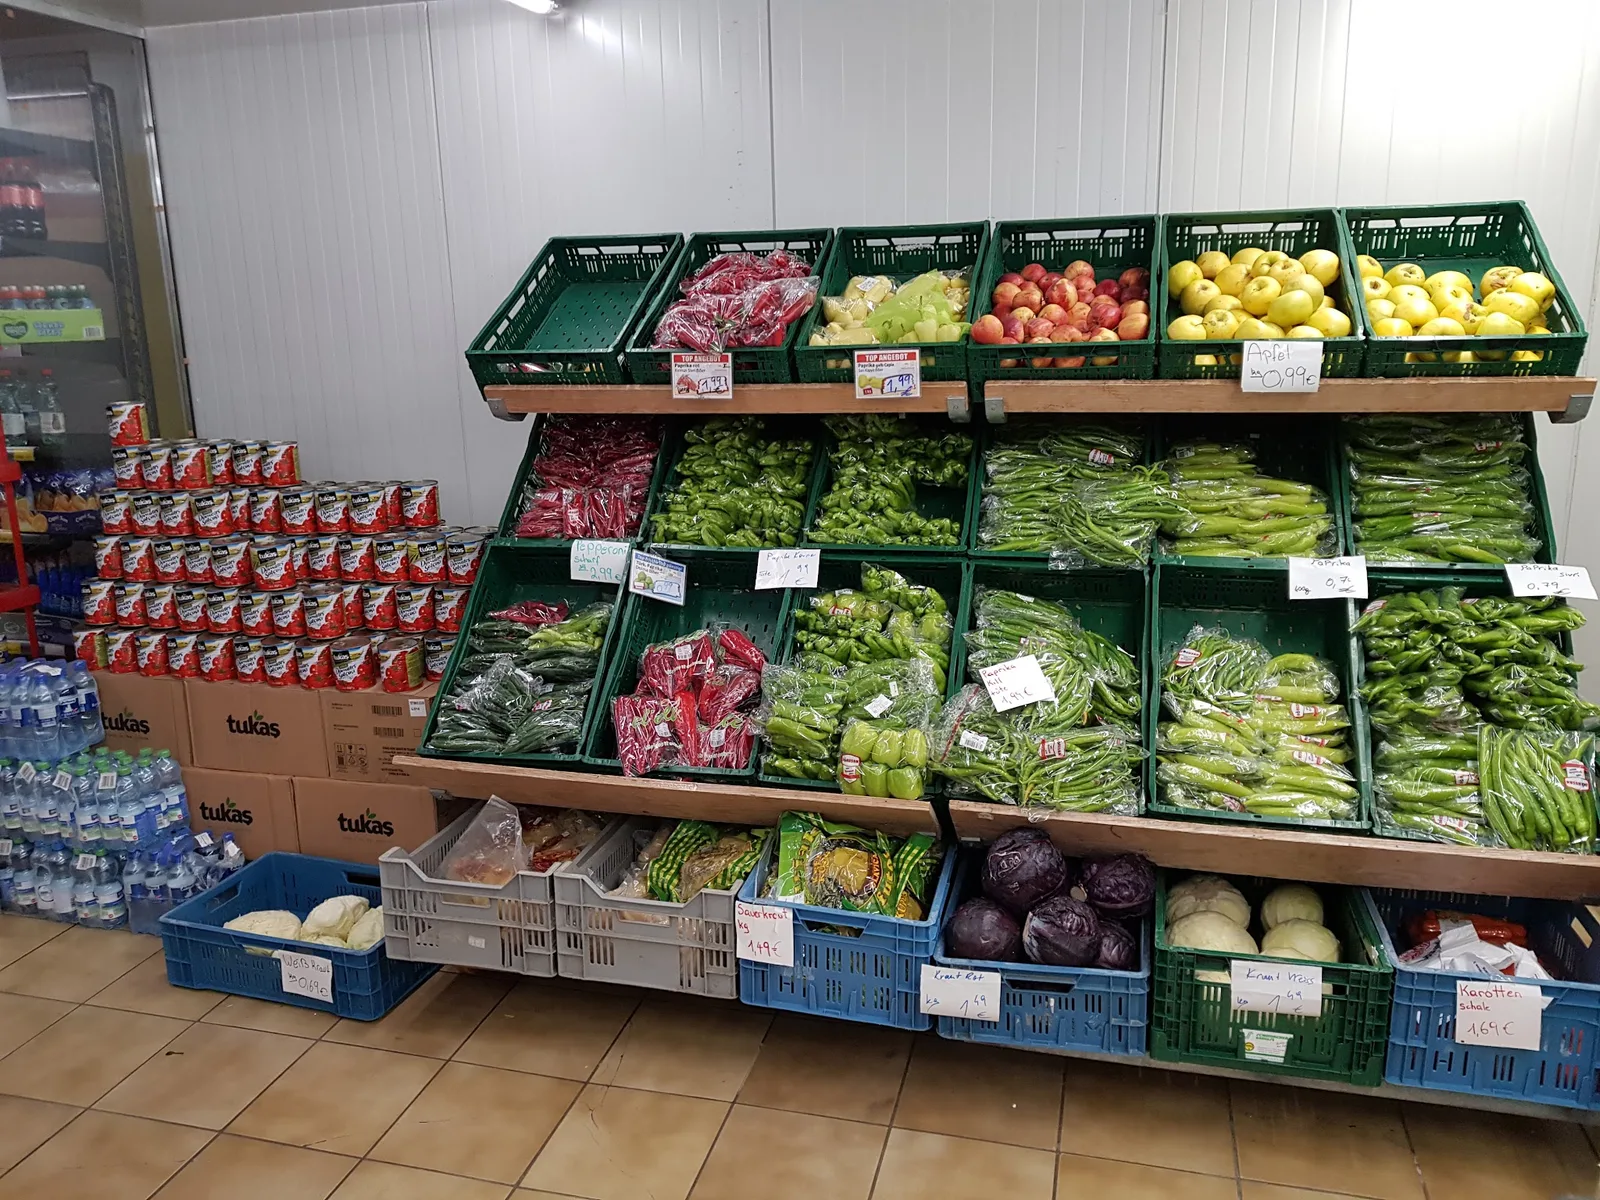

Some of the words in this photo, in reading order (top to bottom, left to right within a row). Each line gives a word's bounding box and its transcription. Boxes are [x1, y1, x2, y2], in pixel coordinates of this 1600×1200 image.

[879, 353, 908, 361] ANGEBOT
[1247, 343, 1290, 364] Apfel
[1262, 366, 1306, 388] 0,99
[1306, 375, 1317, 385] €
[590, 567, 612, 580] 2,99
[1527, 582, 1559, 591] 0,79
[982, 665, 1017, 678] Paprika
[102, 711, 150, 735] tukaş
[226, 714, 281, 739] tukaş
[200, 801, 254, 825] tukaş
[337, 811, 395, 837] tukaş
[738, 919, 750, 934] kg
[747, 940, 771, 957] 1,49
[771, 941, 783, 957] €
[298, 977, 320, 994] 0,69
[1460, 983, 1523, 998] Karotten
[1467, 1021, 1500, 1037] 1,69
[1502, 1021, 1516, 1035] €
